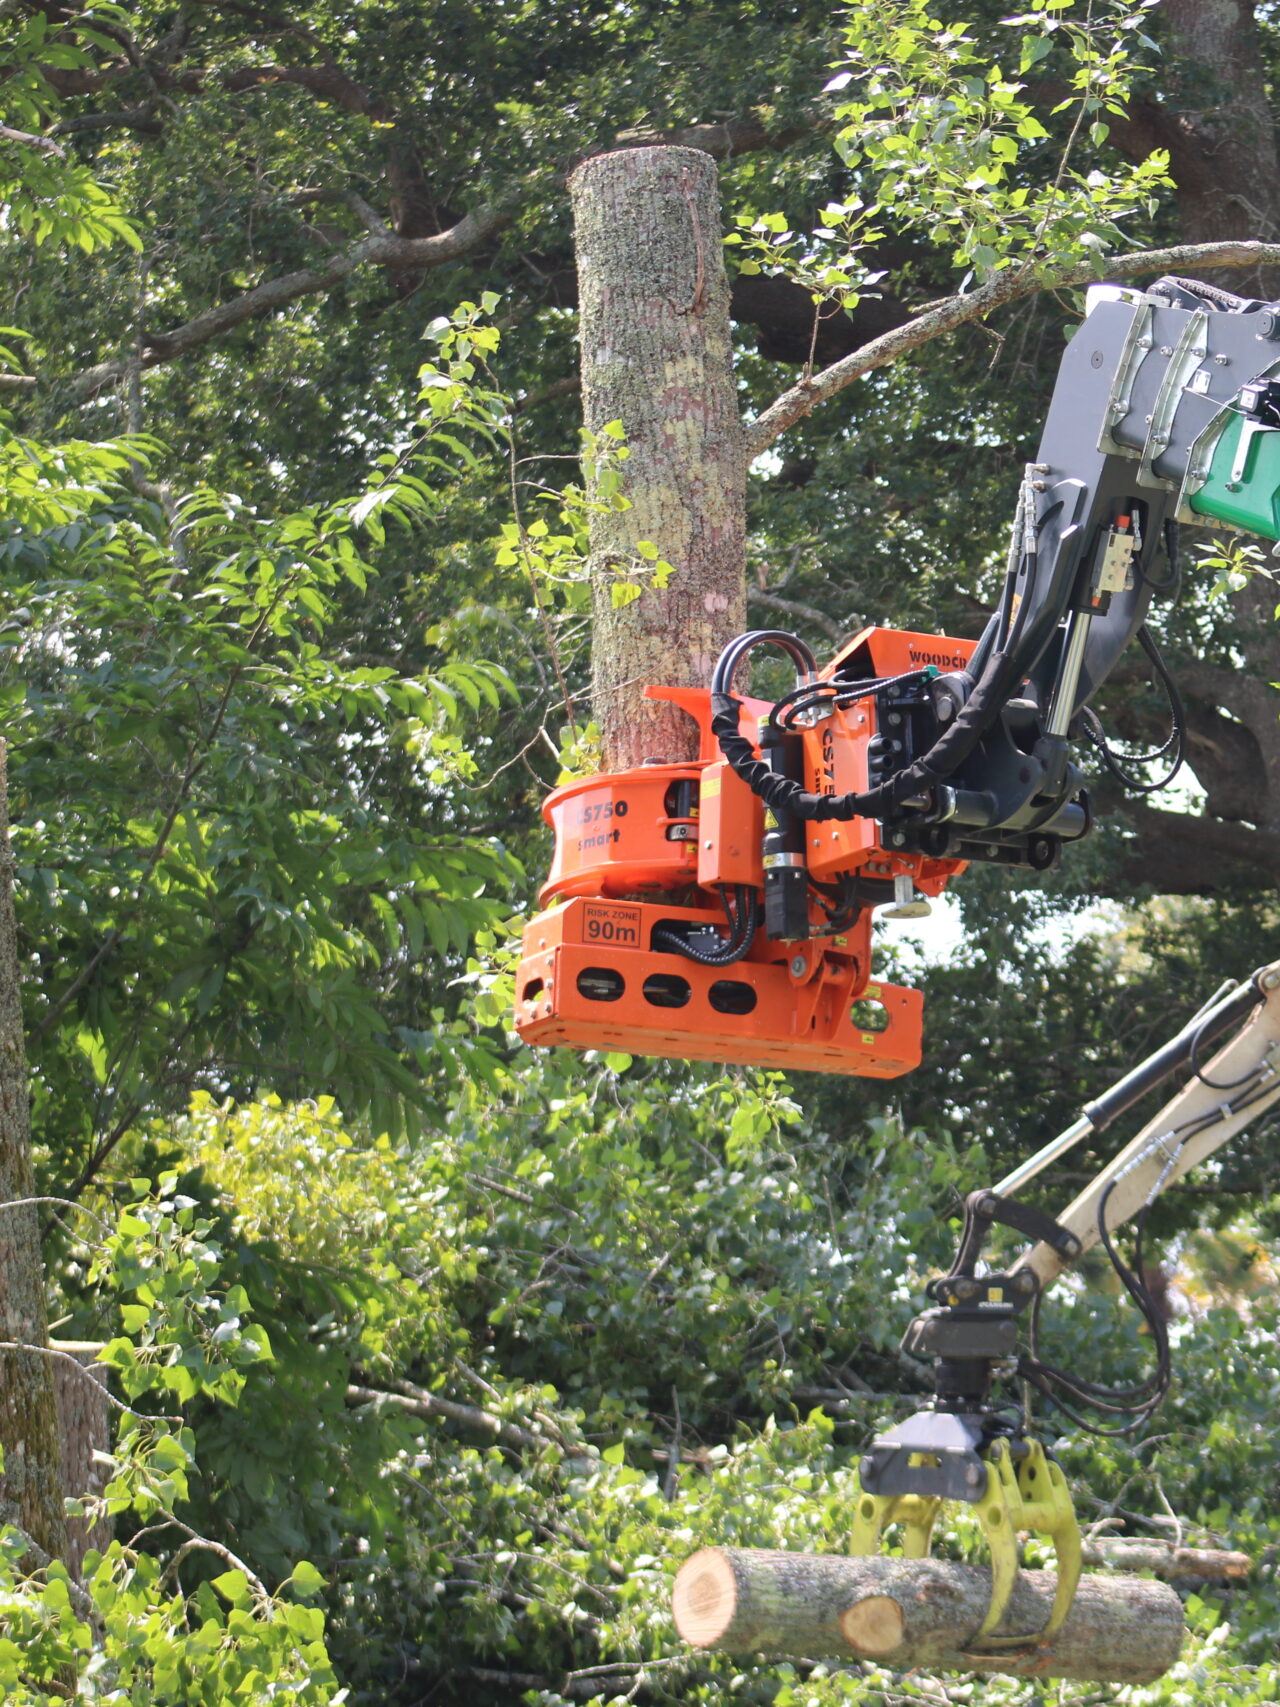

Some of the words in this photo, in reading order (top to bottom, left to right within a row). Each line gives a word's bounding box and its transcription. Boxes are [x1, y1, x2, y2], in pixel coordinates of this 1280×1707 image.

[577, 800, 628, 824] CS750
[578, 829, 620, 851] smart
[587, 908, 609, 918] RISK
[612, 910, 638, 921] ZONE
[588, 919, 636, 942] 90m
